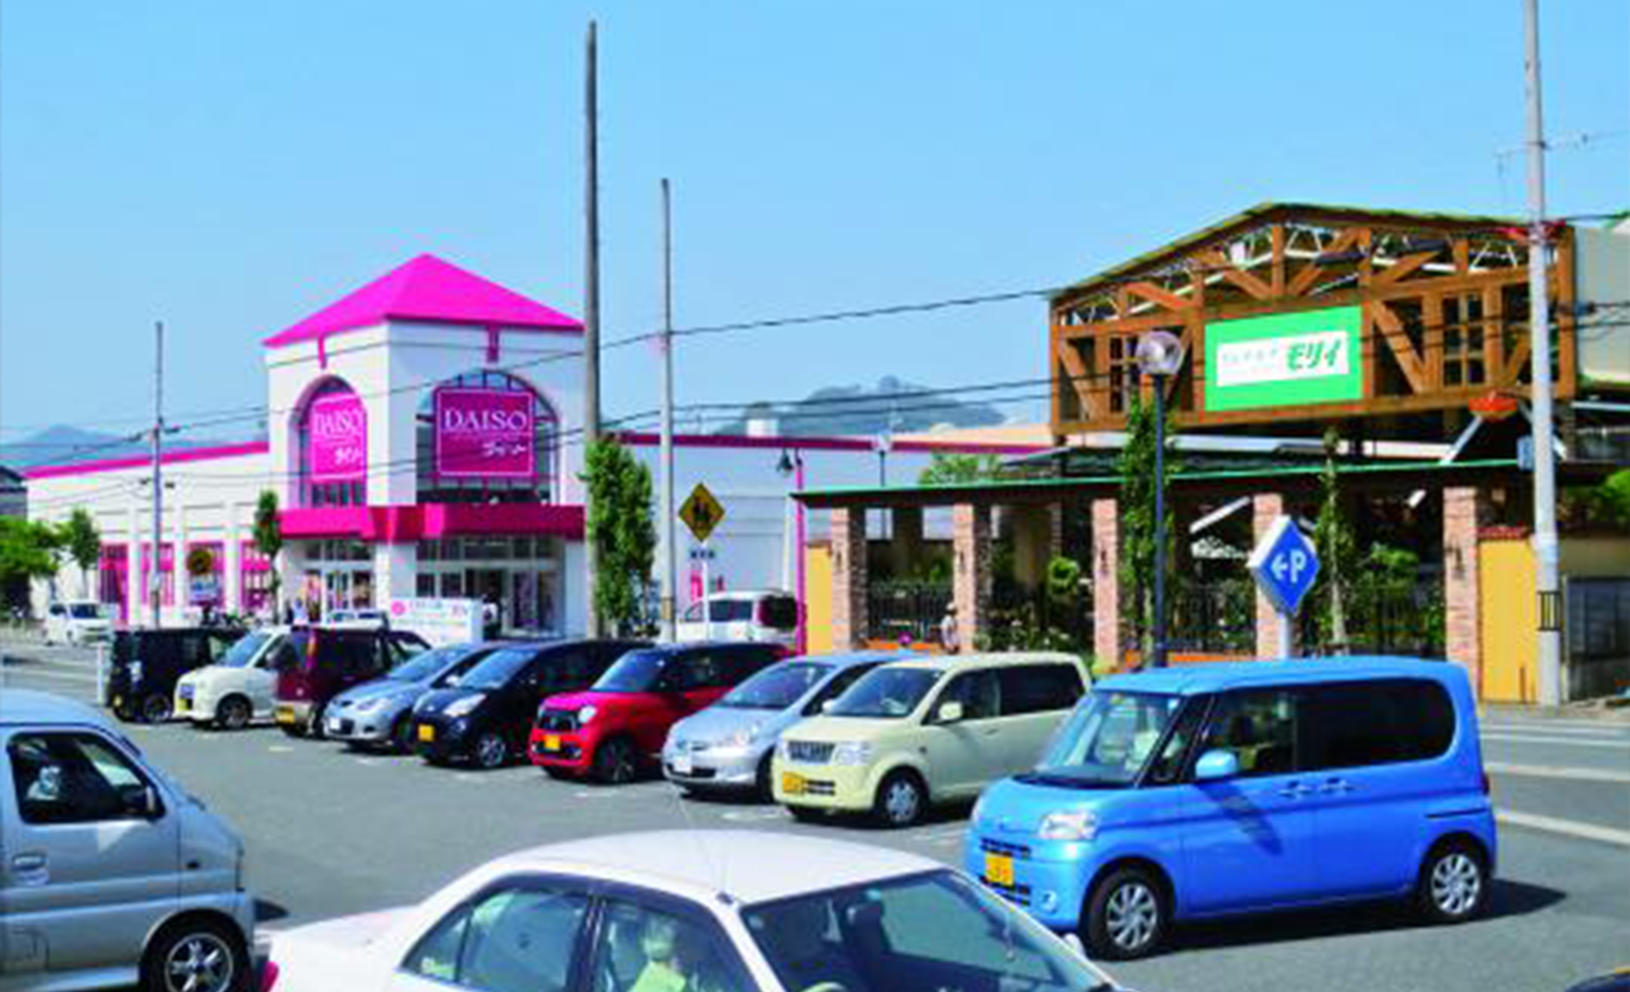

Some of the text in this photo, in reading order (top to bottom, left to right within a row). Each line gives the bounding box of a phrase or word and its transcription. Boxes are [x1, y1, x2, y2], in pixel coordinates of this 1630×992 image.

[1287, 339, 1341, 370] モリイ
[313, 408, 360, 436] DAISO
[444, 409, 528, 430] DAISO
[1290, 549, 1308, 583] P
